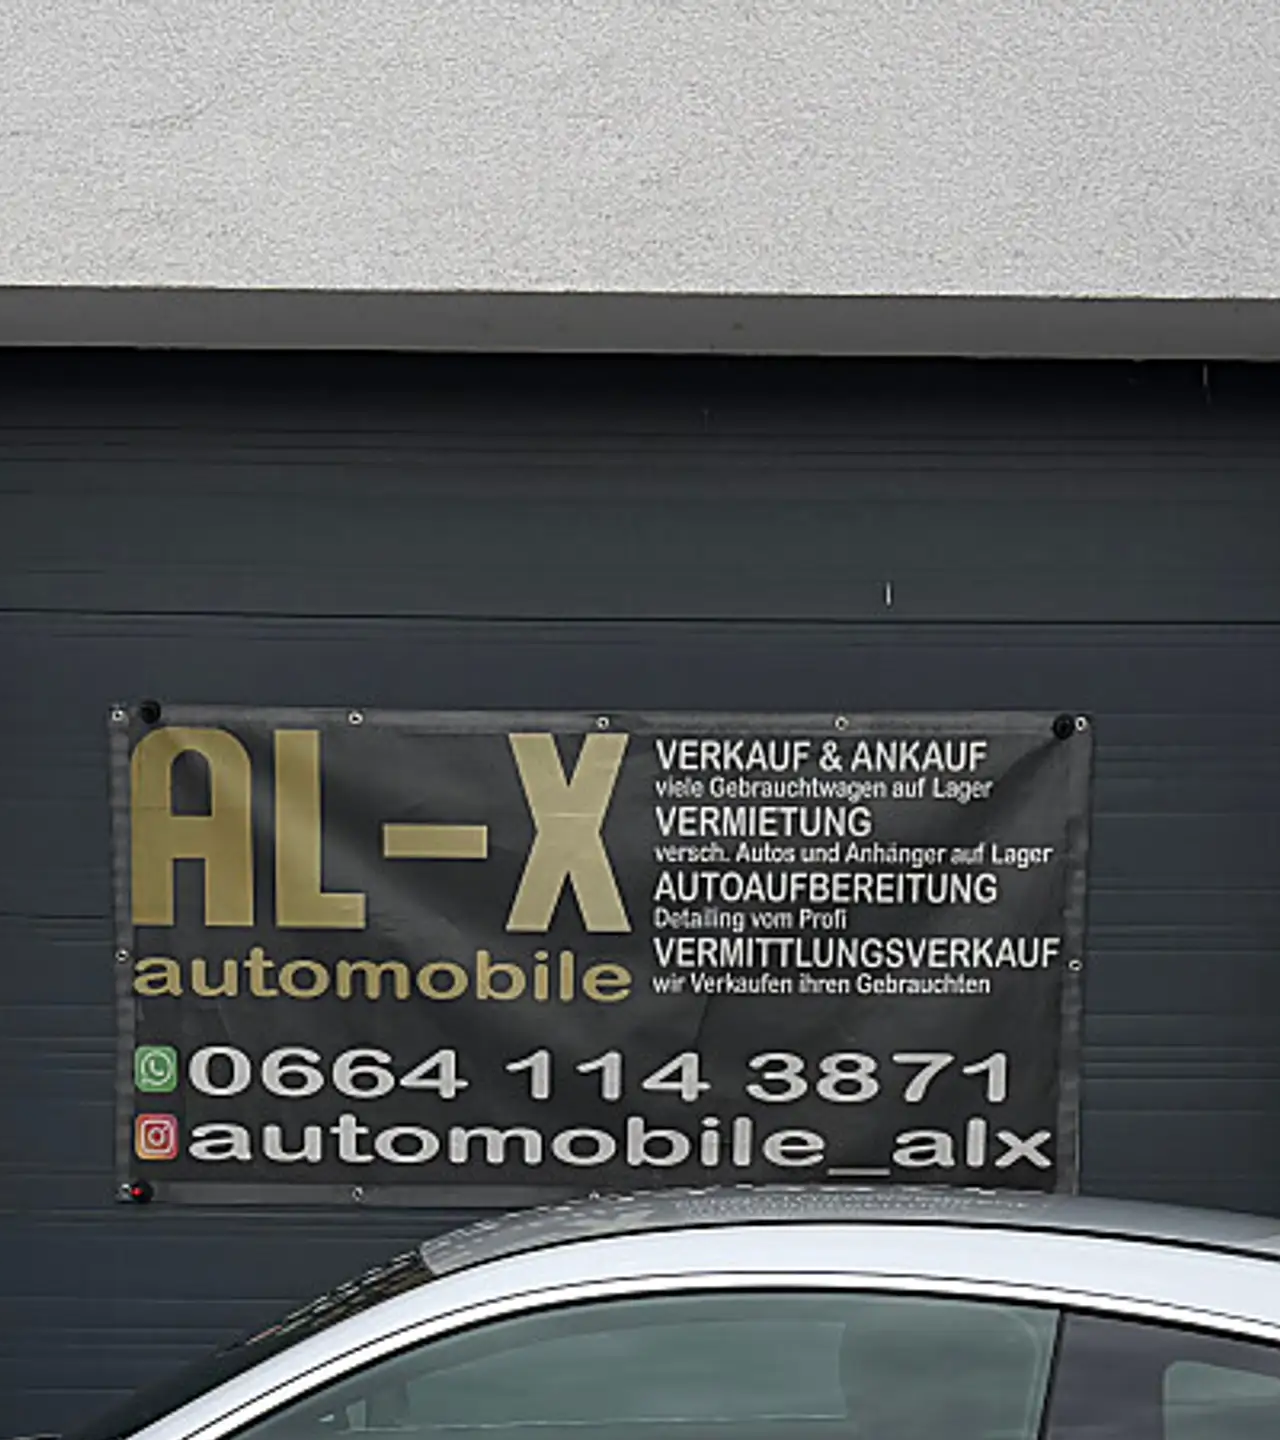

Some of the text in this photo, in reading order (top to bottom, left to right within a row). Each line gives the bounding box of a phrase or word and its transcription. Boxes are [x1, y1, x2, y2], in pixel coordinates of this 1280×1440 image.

[655, 739, 988, 773] VERKAUF & ANKAUF
[654, 777, 994, 803] viele Gebrauchtwagen auf Lager
[130, 726, 632, 934] AL-X
[655, 805, 872, 837] VERMIETUNG
[654, 843, 1054, 869] versch. Autos und Anhänger auf Lager
[653, 871, 998, 904] AUTOAUFBEREITUNG
[654, 908, 848, 932] Detailing vom Profi
[653, 936, 1061, 969] VERMITTLUNGSVERKAUF
[132, 946, 633, 1002] automobile
[652, 972, 992, 995] wir Verkaufen ihren Gebrauchten
[188, 1045, 1008, 1104] 0664 114 3871
[188, 1113, 1053, 1177] automobile_alx
